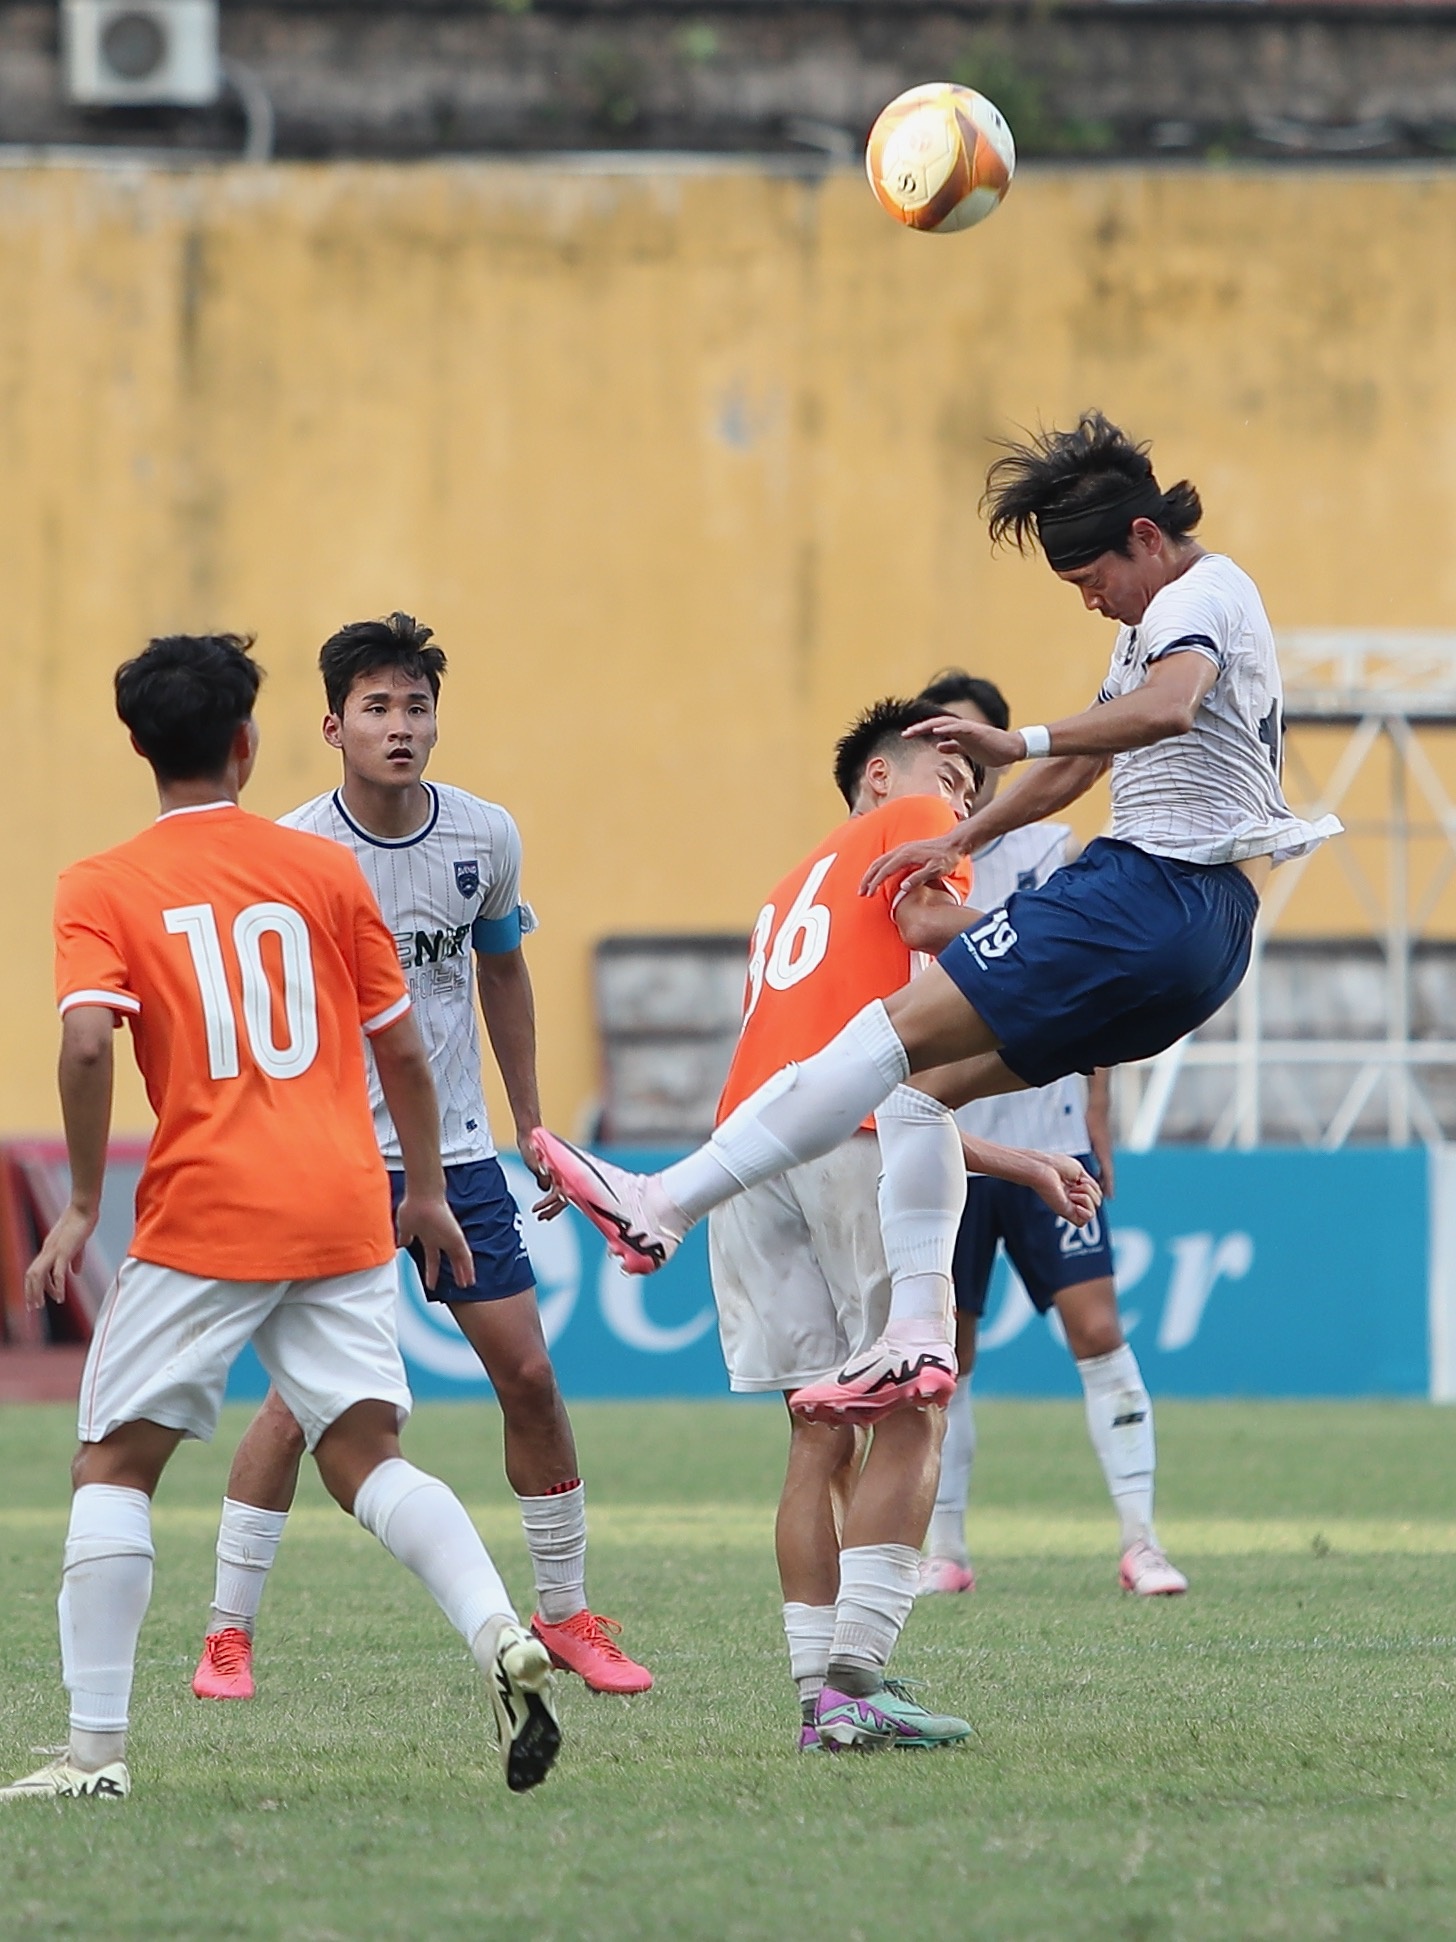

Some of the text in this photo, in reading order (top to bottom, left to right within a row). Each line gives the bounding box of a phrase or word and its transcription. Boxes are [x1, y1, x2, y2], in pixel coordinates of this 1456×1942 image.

[970, 909, 1018, 958] 19
[162, 902, 319, 1080] 10
[1055, 1213, 1101, 1253] 20
